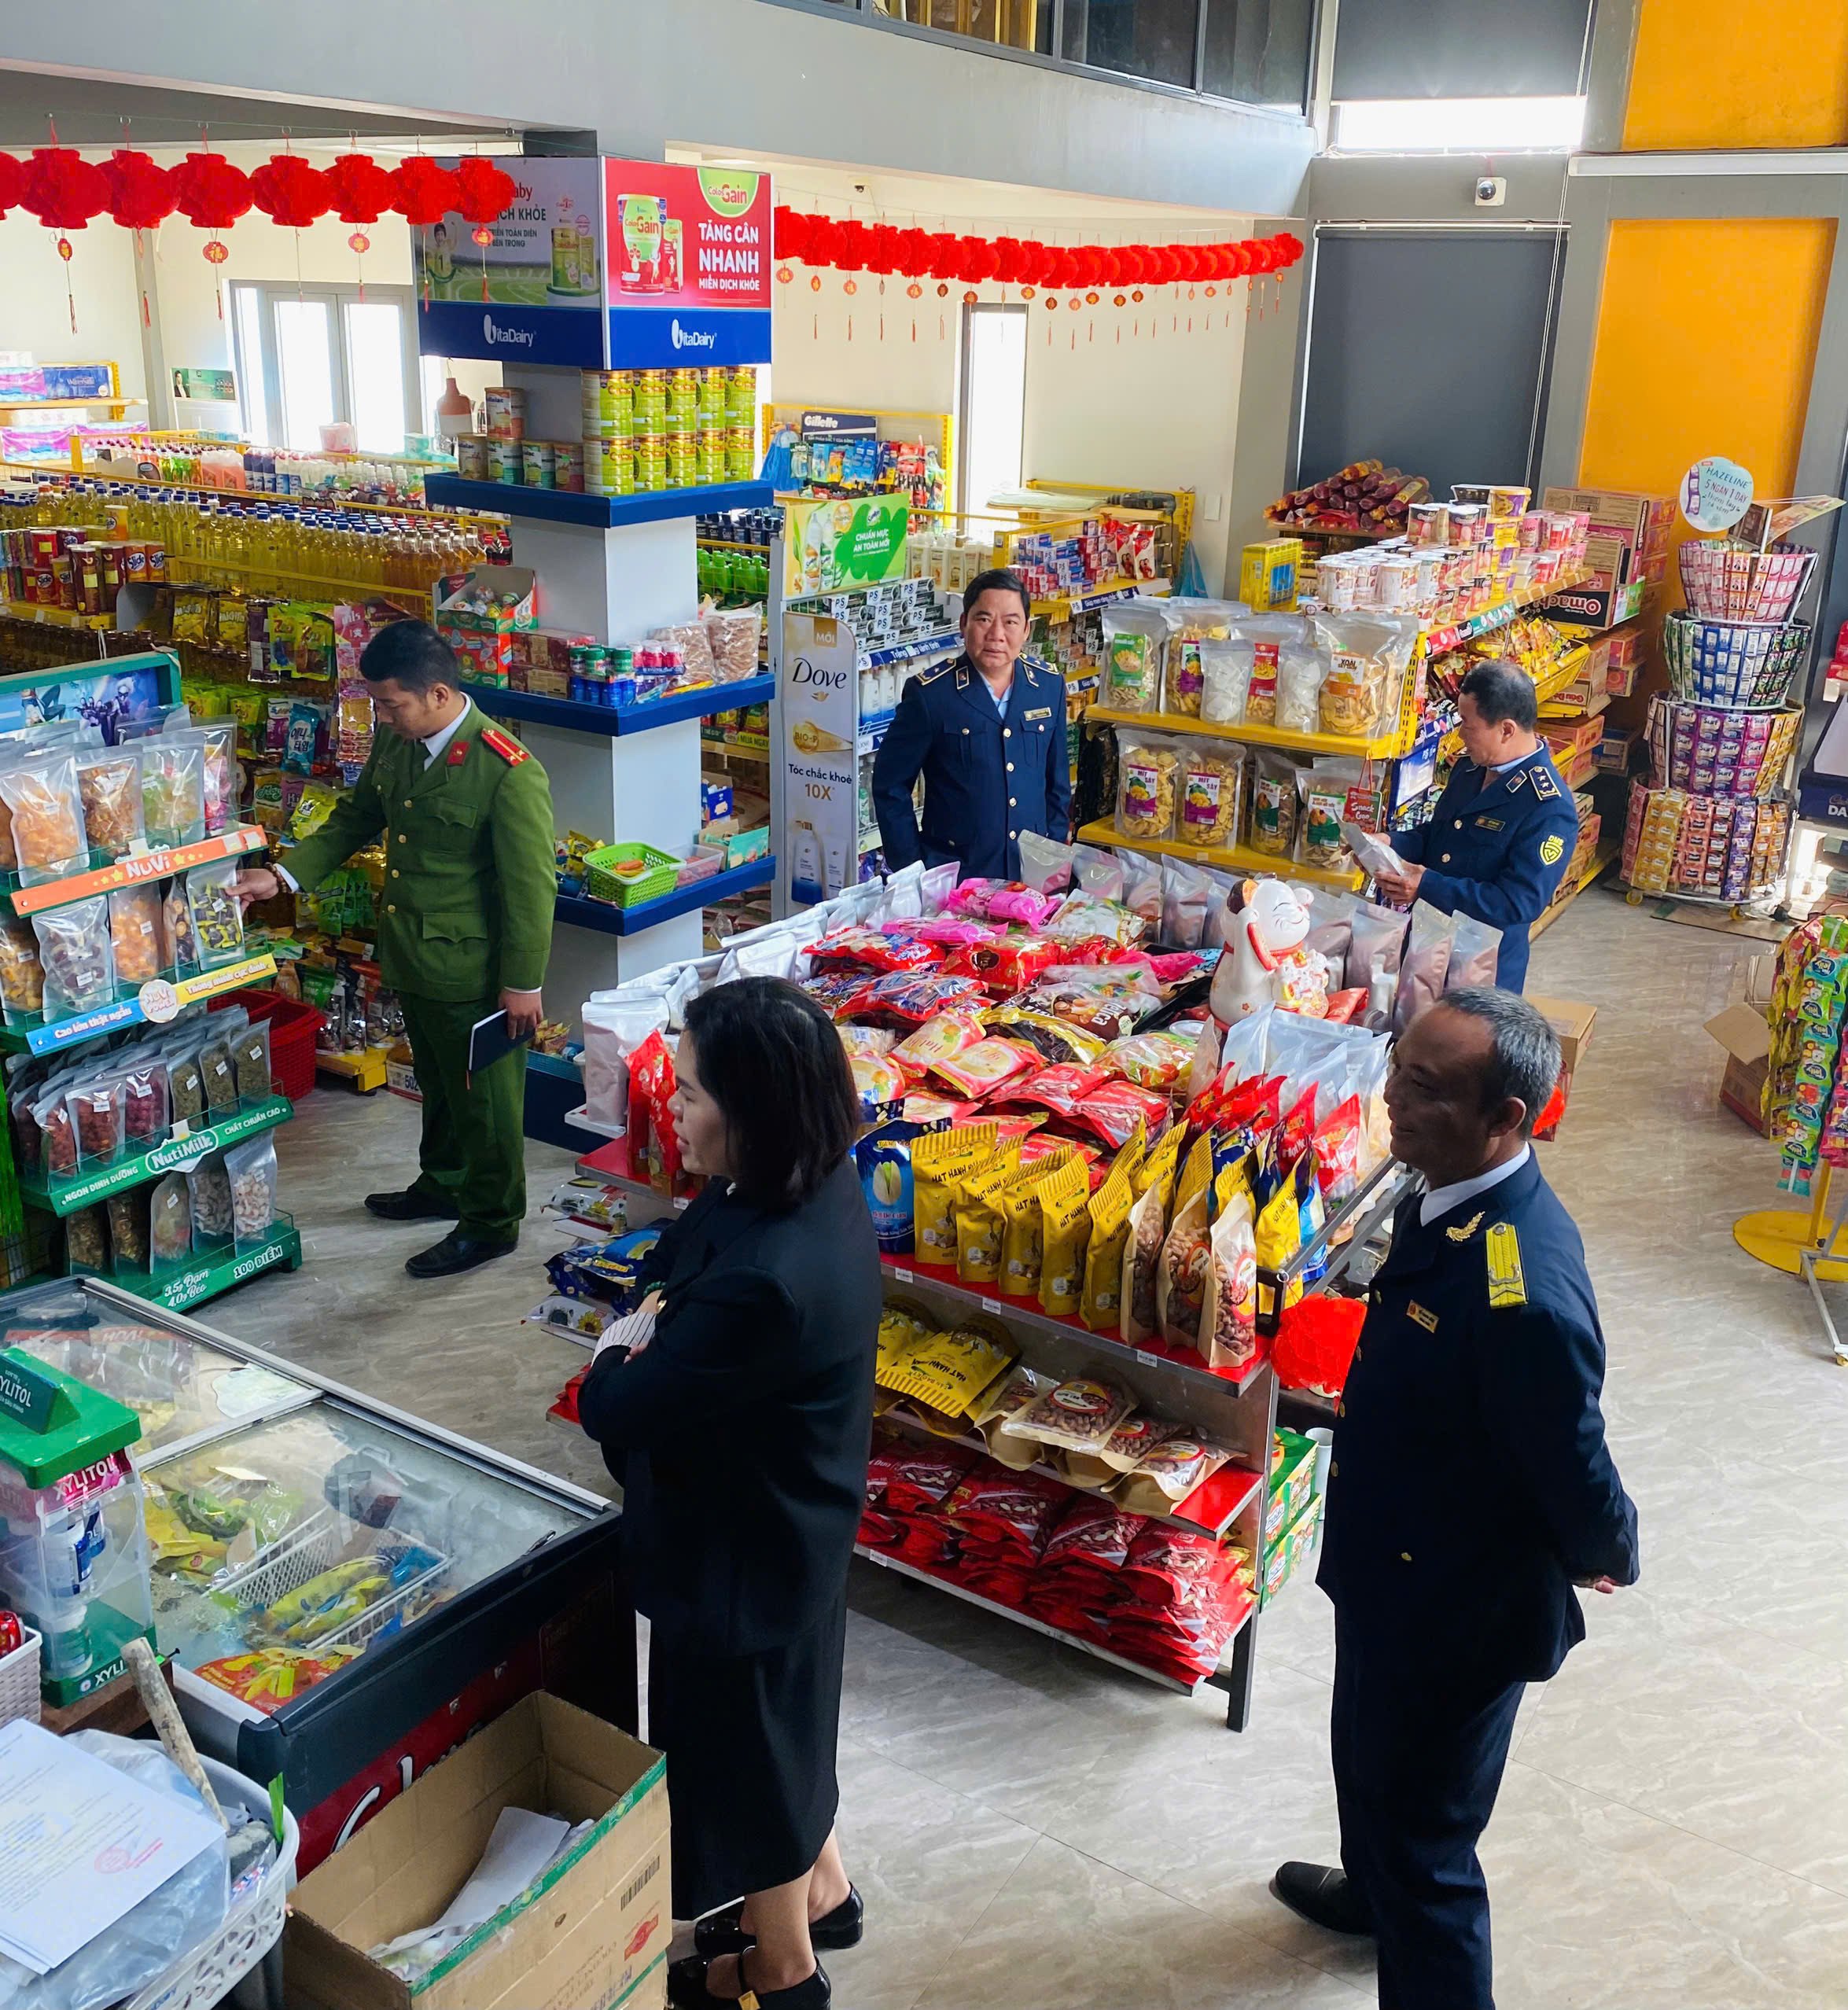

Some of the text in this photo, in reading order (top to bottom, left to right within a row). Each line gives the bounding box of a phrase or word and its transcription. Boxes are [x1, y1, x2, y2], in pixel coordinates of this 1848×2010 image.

[496, 204, 547, 223] ỊCH KHỎE
[698, 219, 759, 245] TĂNG CÂN
[698, 248, 760, 274] NHANH
[720, 278, 738, 293] DỊCH
[484, 314, 535, 348] VitaDairy
[671, 318, 716, 349] VitaDairy
[804, 414, 839, 429] Gillette
[1705, 479, 1711, 488] 5
[1706, 466, 1748, 489] HAZELINE
[853, 543, 861, 553] AN
[862, 540, 879, 551] TOÀN
[150, 554, 164, 568] Slid
[815, 631, 837, 643] MỚI
[792, 657, 847, 690] Dove
[788, 763, 804, 775] Tóc
[805, 768, 827, 780] chắc
[1828, 804, 1848, 818] DA
[125, 854, 171, 880] NuVi
[54, 1028, 72, 1040] Cao
[267, 1107, 281, 1118] CAO
[151, 1133, 213, 1169] NutiMilk
[64, 1186, 89, 1202] NGON
[234, 1261, 255, 1279] 100
[53, 1457, 116, 1501] XYLITOL
[94, 1659, 125, 1687] XYLI
